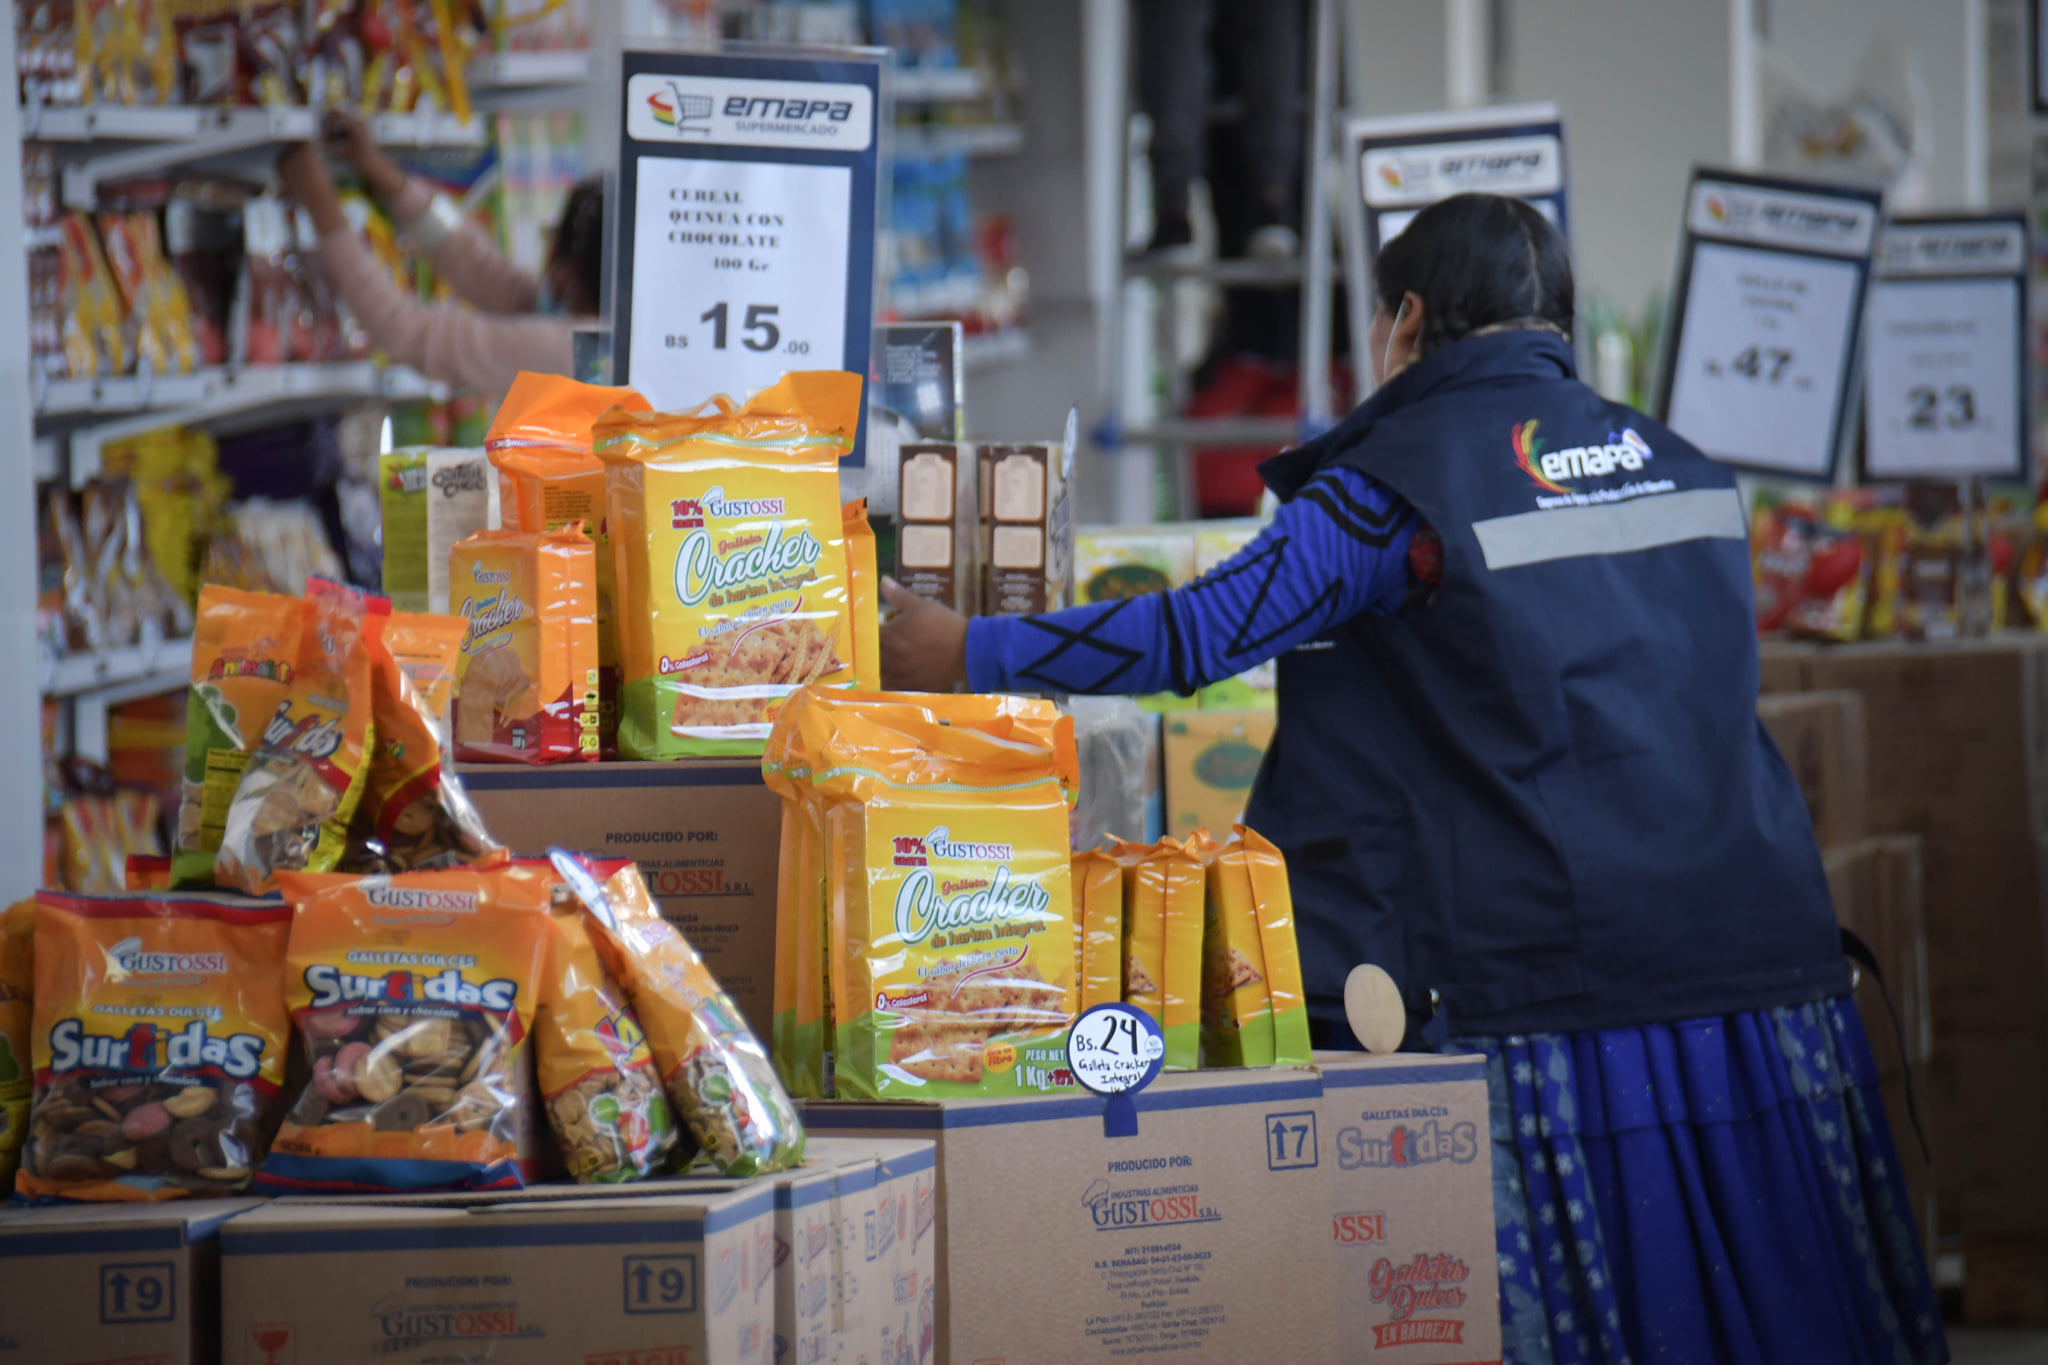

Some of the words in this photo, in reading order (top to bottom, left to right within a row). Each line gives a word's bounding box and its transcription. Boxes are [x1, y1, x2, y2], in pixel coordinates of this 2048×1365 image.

[723, 96, 853, 122] emapa
[735, 120, 838, 136] SUPERMERCADO
[669, 188, 744, 205] CEREAL
[669, 210, 741, 227] QUINUA
[747, 212, 785, 228] CON
[668, 230, 781, 248] CHOCOLATE
[665, 334, 688, 350] BS
[1734, 346, 1793, 386] 47
[1908, 386, 1976, 430] 23
[1540, 442, 1644, 481] emapa
[671, 500, 704, 516] 10%
[709, 498, 784, 517] GUSTOSSI
[674, 519, 821, 608] Cracker
[474, 570, 510, 584] GUSTOSSI
[709, 592, 724, 608] de
[726, 584, 768, 604] harina
[710, 620, 734, 636] sabor
[770, 598, 794, 614] gusto
[606, 832, 684, 844] PRODUCIDO
[688, 831, 718, 842] POR:
[892, 837, 926, 854] 10%
[934, 840, 1014, 862] GUSTOSSI
[368, 886, 478, 914] GUSTOSSI
[894, 864, 1050, 946] Cracker
[930, 933, 946, 949] de
[949, 926, 993, 946] harina
[120, 950, 226, 973] GUSTOSSI
[346, 951, 418, 967] GALLETAS
[421, 954, 477, 968] DULCES
[918, 966, 928, 978] El
[928, 962, 956, 977] sabor
[956, 957, 970, 970] del
[971, 950, 992, 963] buen
[994, 946, 1020, 960] gusto
[93, 1003, 166, 1018] GALLETAS
[1076, 1034, 1098, 1052] Bs.
[1101, 1015, 1138, 1056] 24
[1026, 1048, 1046, 1062] PESO
[1048, 1048, 1068, 1062] NET
[1078, 1058, 1112, 1072] Galleta
[1114, 1058, 1150, 1072] Cracker
[1014, 1064, 1023, 1088] 1
[1101, 1072, 1143, 1090] Integral
[1362, 1110, 1410, 1121] GALLETAS
[1412, 1106, 1448, 1118] DULCES
[1108, 1158, 1167, 1173] PRODUCIDO
[1169, 1156, 1192, 1168] POR:
[1110, 1187, 1152, 1200] INDUSTRIAS
[1152, 1184, 1198, 1196] ALIMENTICIAS
[1089, 1195, 1199, 1226] GUSTOSSI
[404, 1275, 478, 1289] PRODUCIDO
[658, 1268, 686, 1304] 9
[1369, 1252, 1470, 1304] Galletas
[136, 1276, 164, 1312] 9
[1390, 1282, 1466, 1322] Dulces
[382, 1310, 516, 1338] GUSTOSSI
[1382, 1324, 1398, 1344] EN
[1400, 1321, 1456, 1342] BANDEJA
